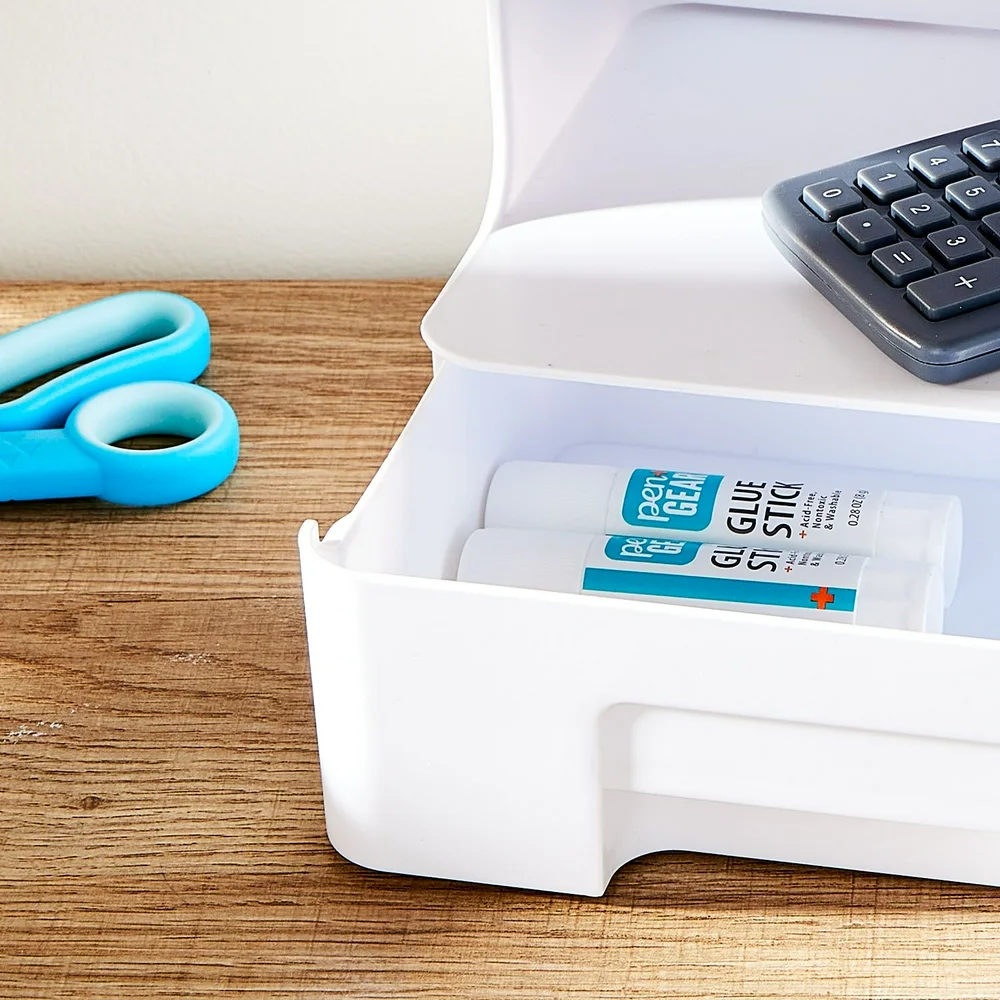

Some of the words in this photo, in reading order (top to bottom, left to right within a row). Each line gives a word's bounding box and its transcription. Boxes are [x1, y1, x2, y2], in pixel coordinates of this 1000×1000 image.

[929, 157, 948, 167] 4
[878, 173, 897, 182] 1
[822, 188, 842, 199] 0
[964, 186, 986, 198] 5
[909, 204, 931, 215] 2
[946, 236, 966, 246] 3
[727, 480, 767, 534] GLUE
[763, 481, 804, 539] STICK
[848, 509, 861, 526] 0.28
